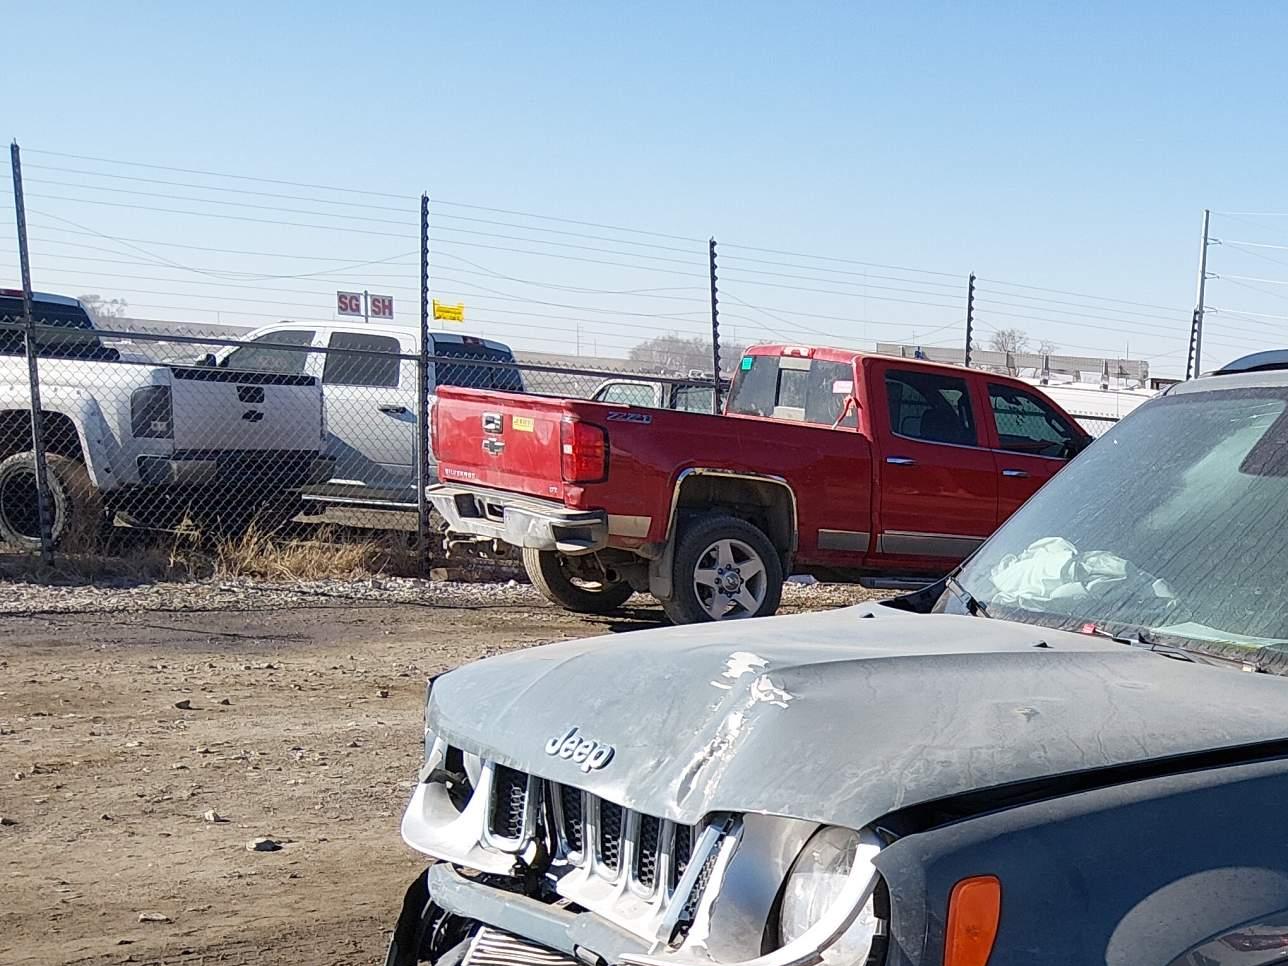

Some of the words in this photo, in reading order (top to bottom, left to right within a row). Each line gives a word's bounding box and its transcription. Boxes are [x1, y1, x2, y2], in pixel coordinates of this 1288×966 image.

[338, 294, 360, 313] SG
[371, 298, 393, 316] SH
[545, 727, 615, 773] Jeep
